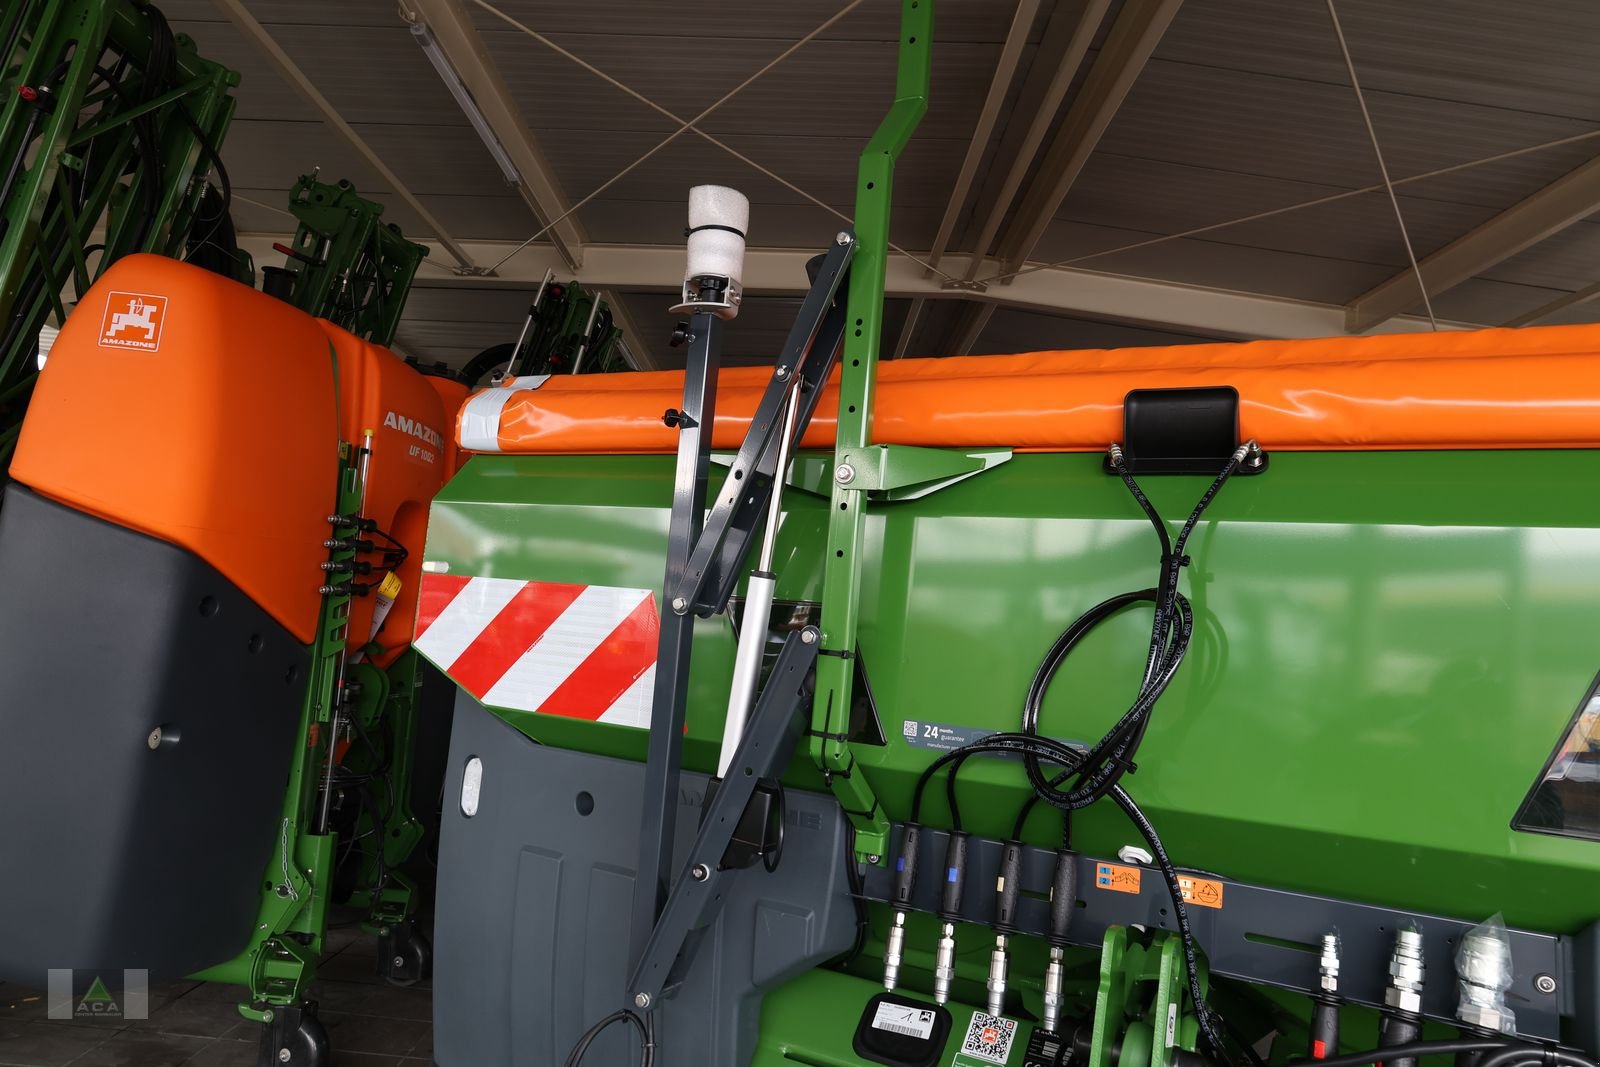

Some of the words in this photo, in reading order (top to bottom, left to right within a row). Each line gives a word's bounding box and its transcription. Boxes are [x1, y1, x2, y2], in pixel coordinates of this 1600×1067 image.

[101, 338, 156, 348] AMAZONE
[409, 445, 420, 456] UF
[924, 725, 938, 739] 24
[940, 735, 965, 743] guarantee
